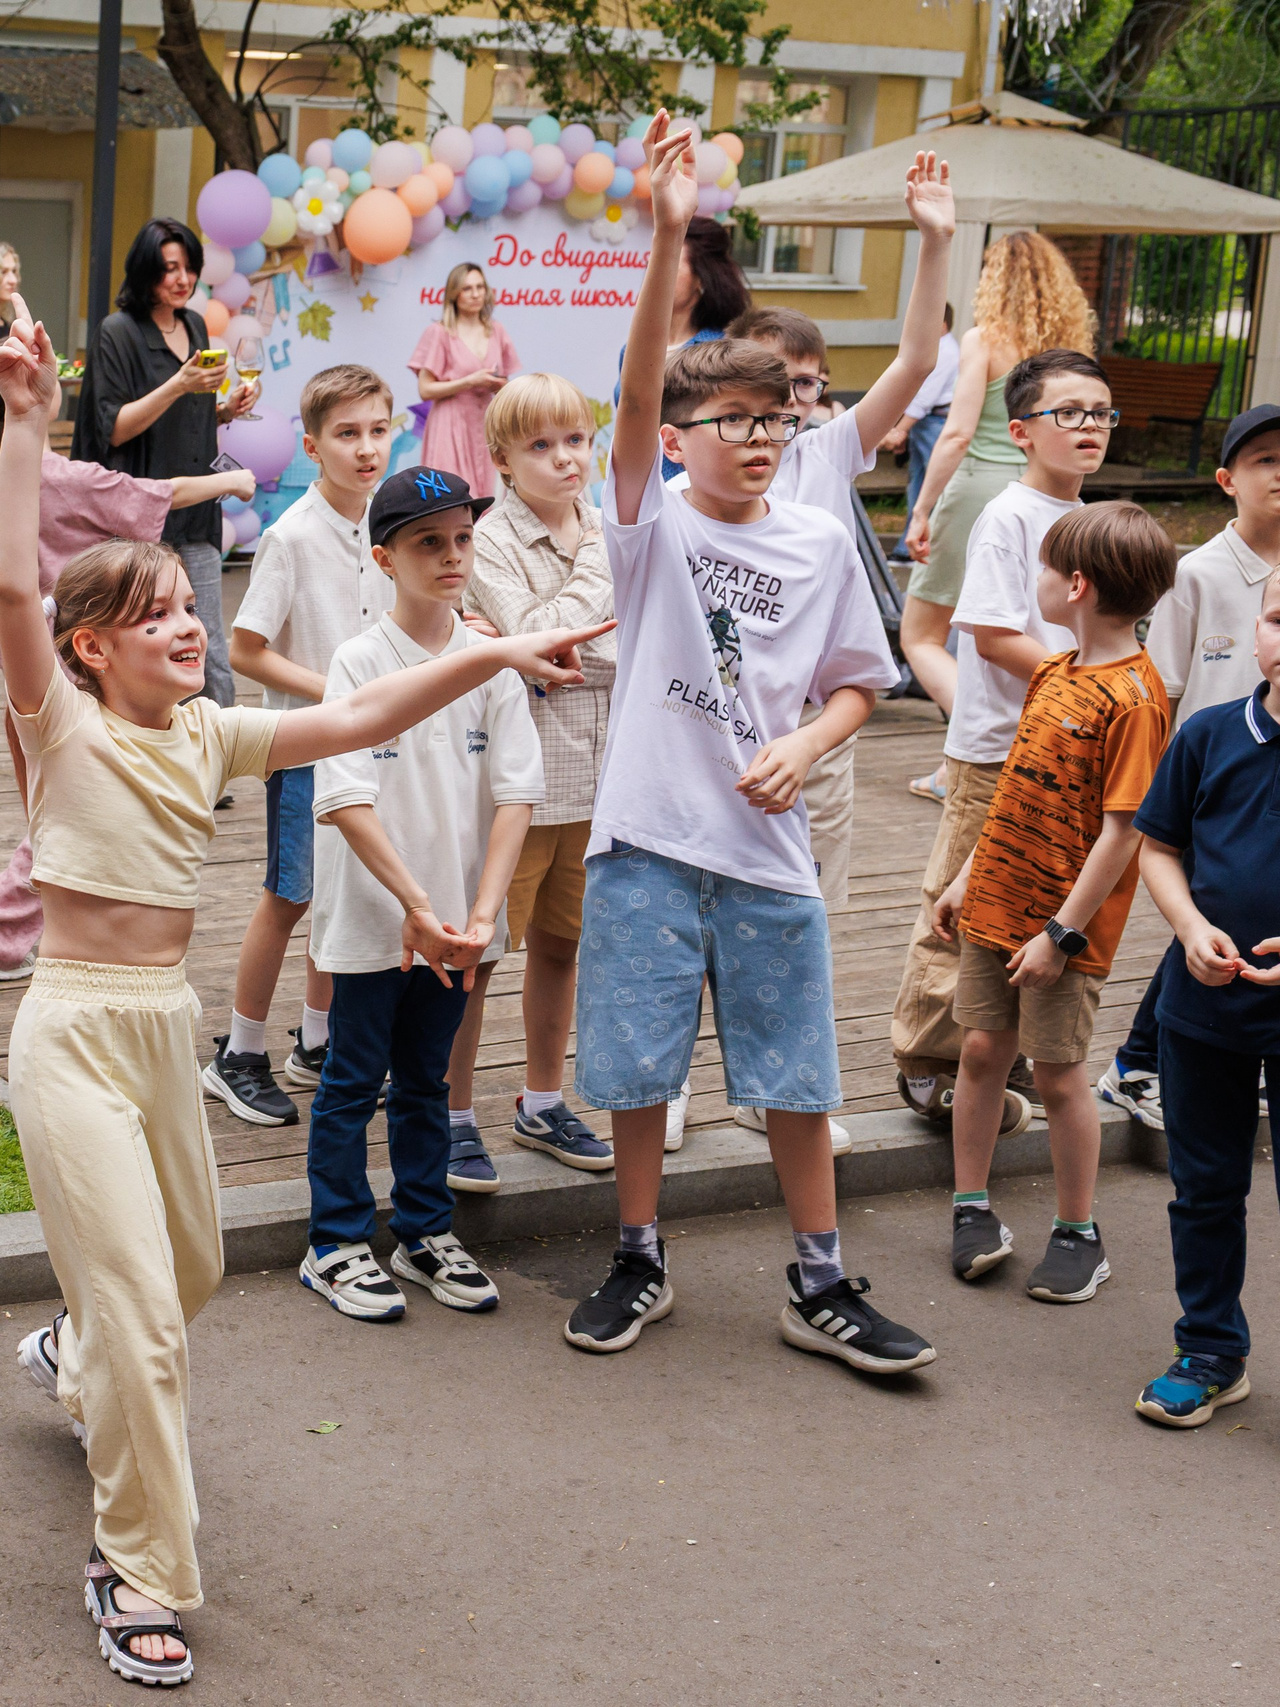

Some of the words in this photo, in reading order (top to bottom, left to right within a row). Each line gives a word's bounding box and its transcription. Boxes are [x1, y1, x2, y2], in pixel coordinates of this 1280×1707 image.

[488, 233, 535, 267] До
[541, 232, 652, 284] свидания
[570, 286, 640, 307] школ
[699, 555, 782, 597] REATED
[702, 574, 784, 624] NATURE
[662, 699, 689, 716] NOT
[690, 708, 704, 720] IN
[667, 678, 730, 722] PLEAS
[734, 719, 757, 744] SA
